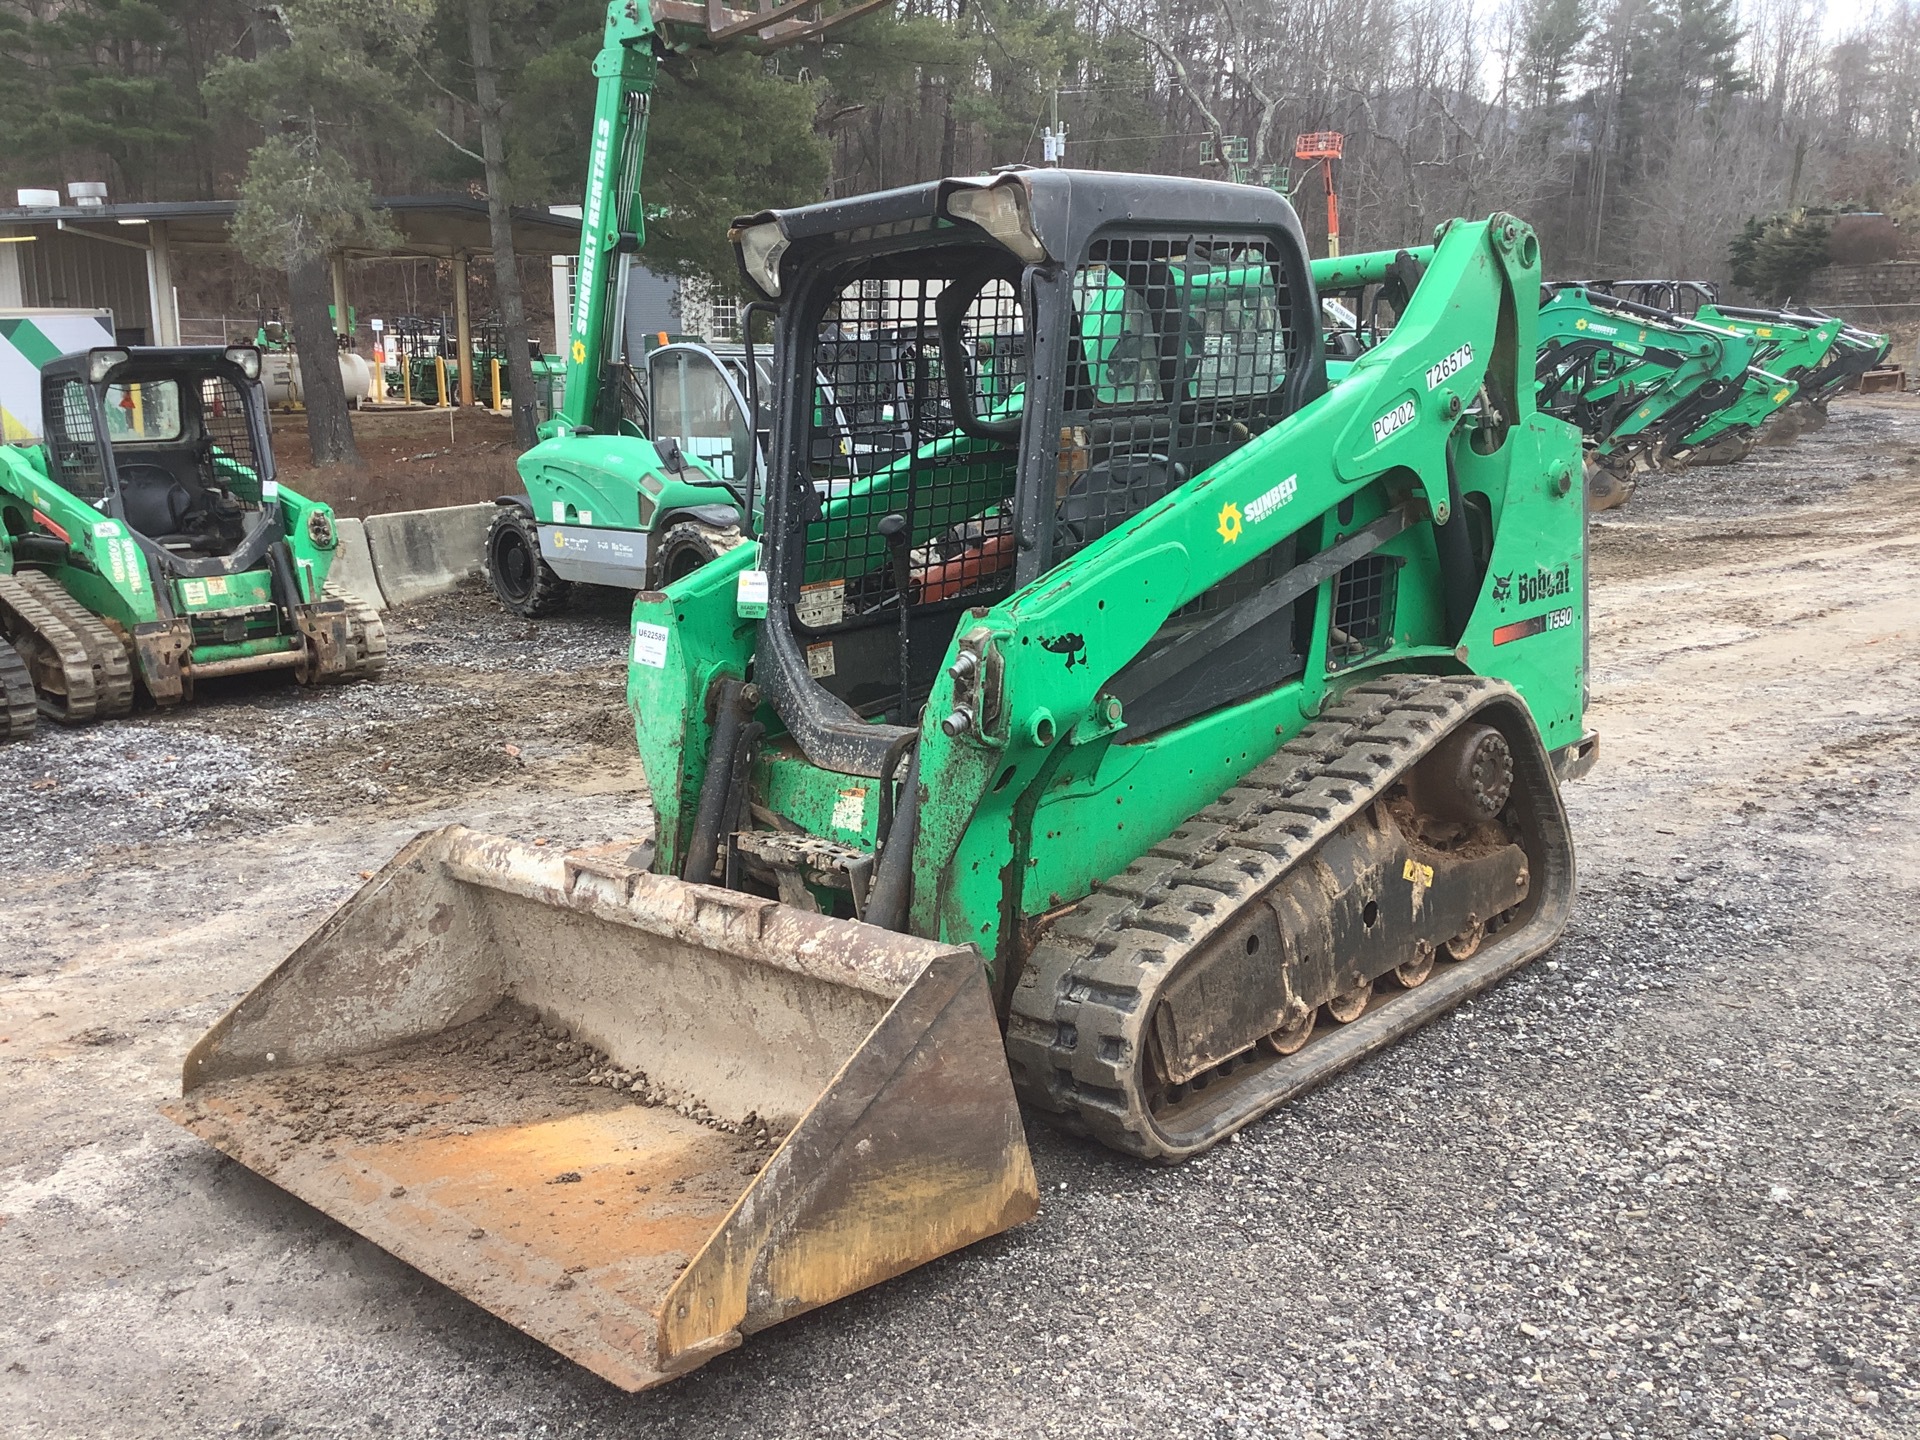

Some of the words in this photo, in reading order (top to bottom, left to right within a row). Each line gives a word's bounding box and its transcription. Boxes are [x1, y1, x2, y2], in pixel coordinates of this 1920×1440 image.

[577, 231, 597, 336] SUNBELT
[588, 118, 610, 229] RENTALS
[1588, 323, 1618, 334] SUNBELT
[1426, 343, 1473, 389] 726579
[1373, 401, 1415, 442] PC202
[1244, 473, 1298, 522] SUNBELT
[1254, 494, 1294, 525] RENTALS
[1518, 564, 1570, 605] Bobcat
[638, 629, 666, 642] U622589
[1548, 606, 1573, 631] T590
